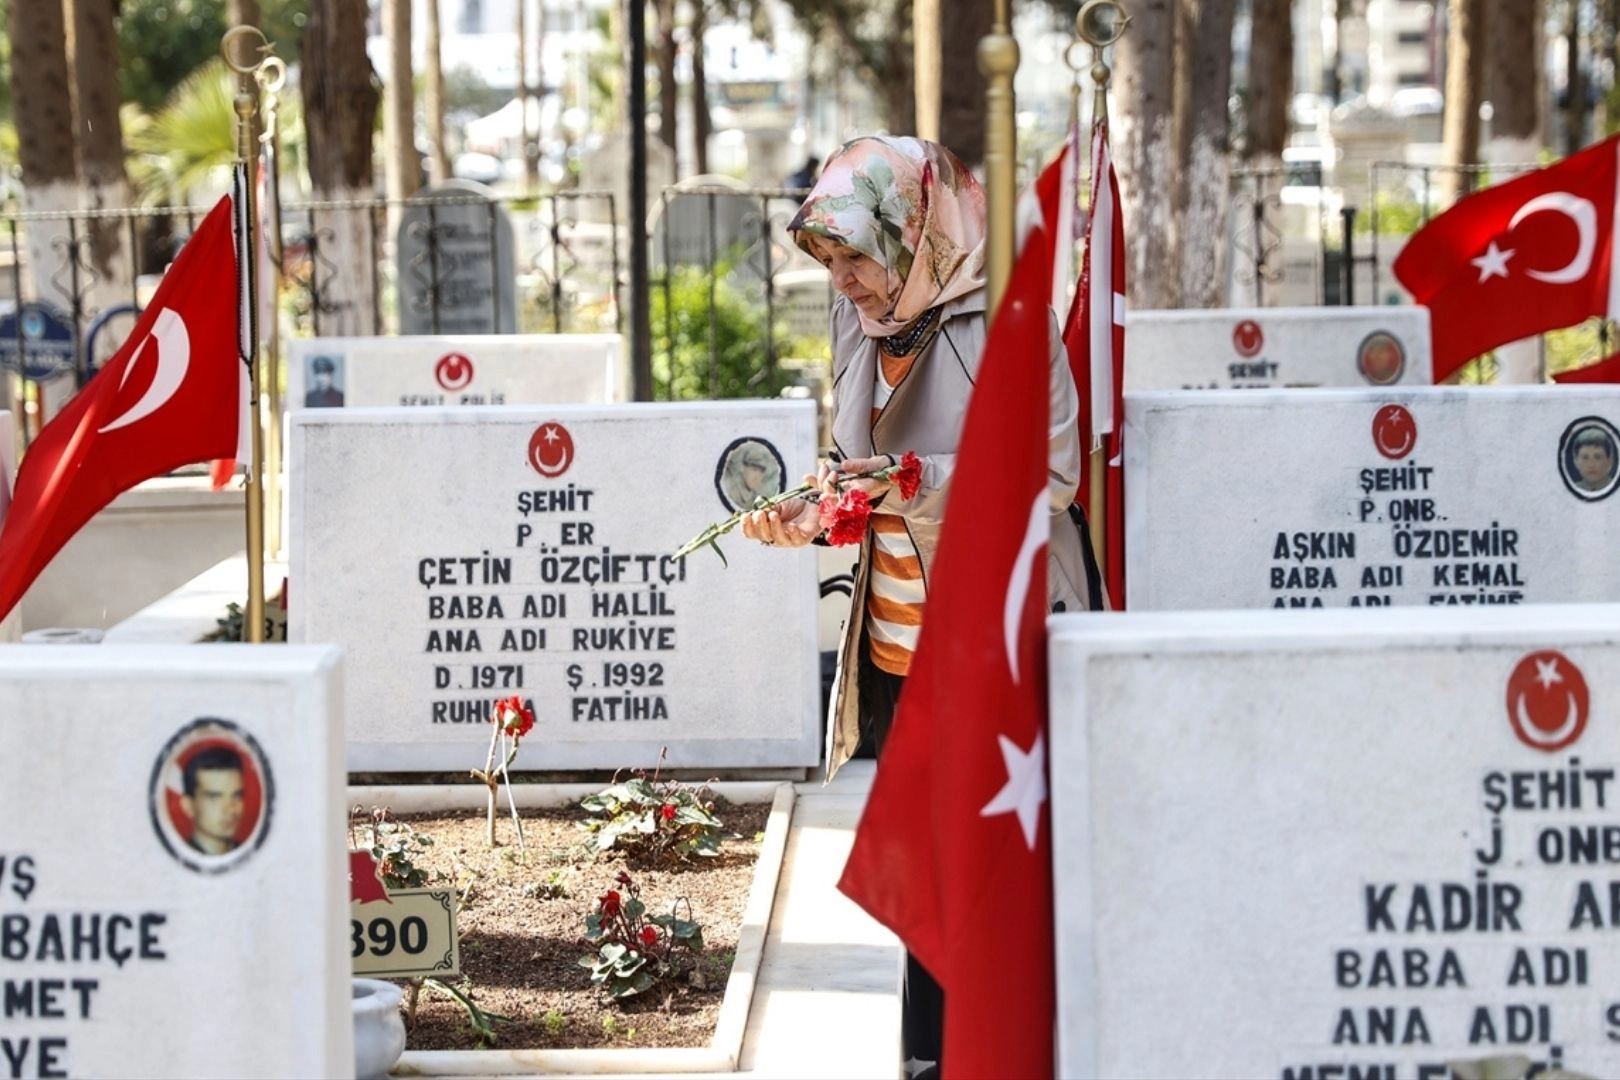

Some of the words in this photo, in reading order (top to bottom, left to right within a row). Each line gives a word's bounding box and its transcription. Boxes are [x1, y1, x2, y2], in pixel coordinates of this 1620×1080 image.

[1360, 459, 1434, 495] ŞEHİT
[517, 482, 594, 517] ŞEHİT
[560, 522, 594, 546] ER
[1273, 532, 1356, 564] AŞKIN
[1392, 521, 1519, 559] ÖZDEMİR
[418, 548, 512, 586] ÇETİN
[1270, 567, 1338, 590] BABA
[1360, 565, 1403, 588] ADI
[1433, 562, 1525, 588] KEMAL
[428, 595, 505, 620] BABA
[522, 593, 566, 619] ADI
[592, 583, 676, 618] HALİL
[425, 629, 482, 653] ANA
[500, 628, 547, 652] ADI
[572, 620, 675, 651] RUKİYE
[432, 700, 538, 724] RUHUA
[571, 689, 669, 722] FATİHA
[1483, 757, 1615, 818] ŞEHİT
[0, 855, 36, 901] Ş
[1365, 870, 1523, 933] KADİR
[0, 912, 167, 968] BAHÇE
[1335, 948, 1466, 989] BABA
[1507, 947, 1588, 986] ADI
[3, 978, 99, 1019] MET
[1332, 1006, 1431, 1045] ANA
[1468, 1005, 1552, 1043] ADI
[0, 1036, 68, 1080] YE
